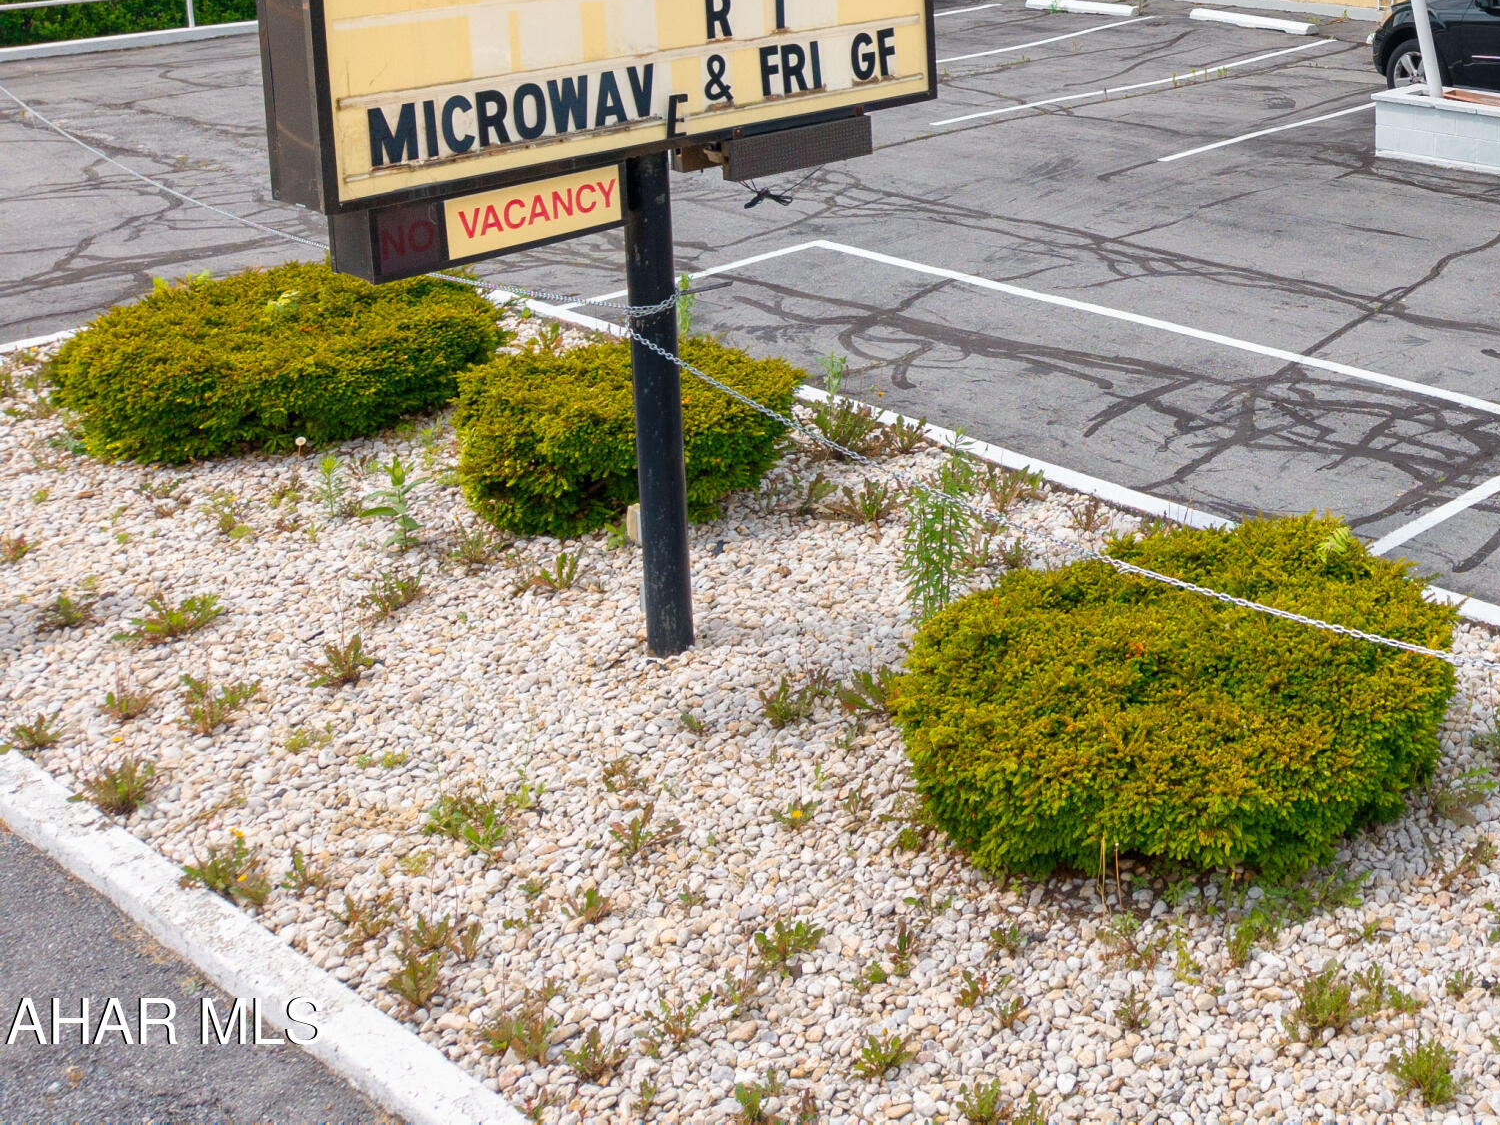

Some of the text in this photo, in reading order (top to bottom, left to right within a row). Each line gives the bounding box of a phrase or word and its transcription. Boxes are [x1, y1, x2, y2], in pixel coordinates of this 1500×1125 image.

[704, 55, 734, 108] &
[760, 41, 821, 96] FRI
[851, 28, 896, 81] GF
[379, 179, 617, 261] NO VACANCY
